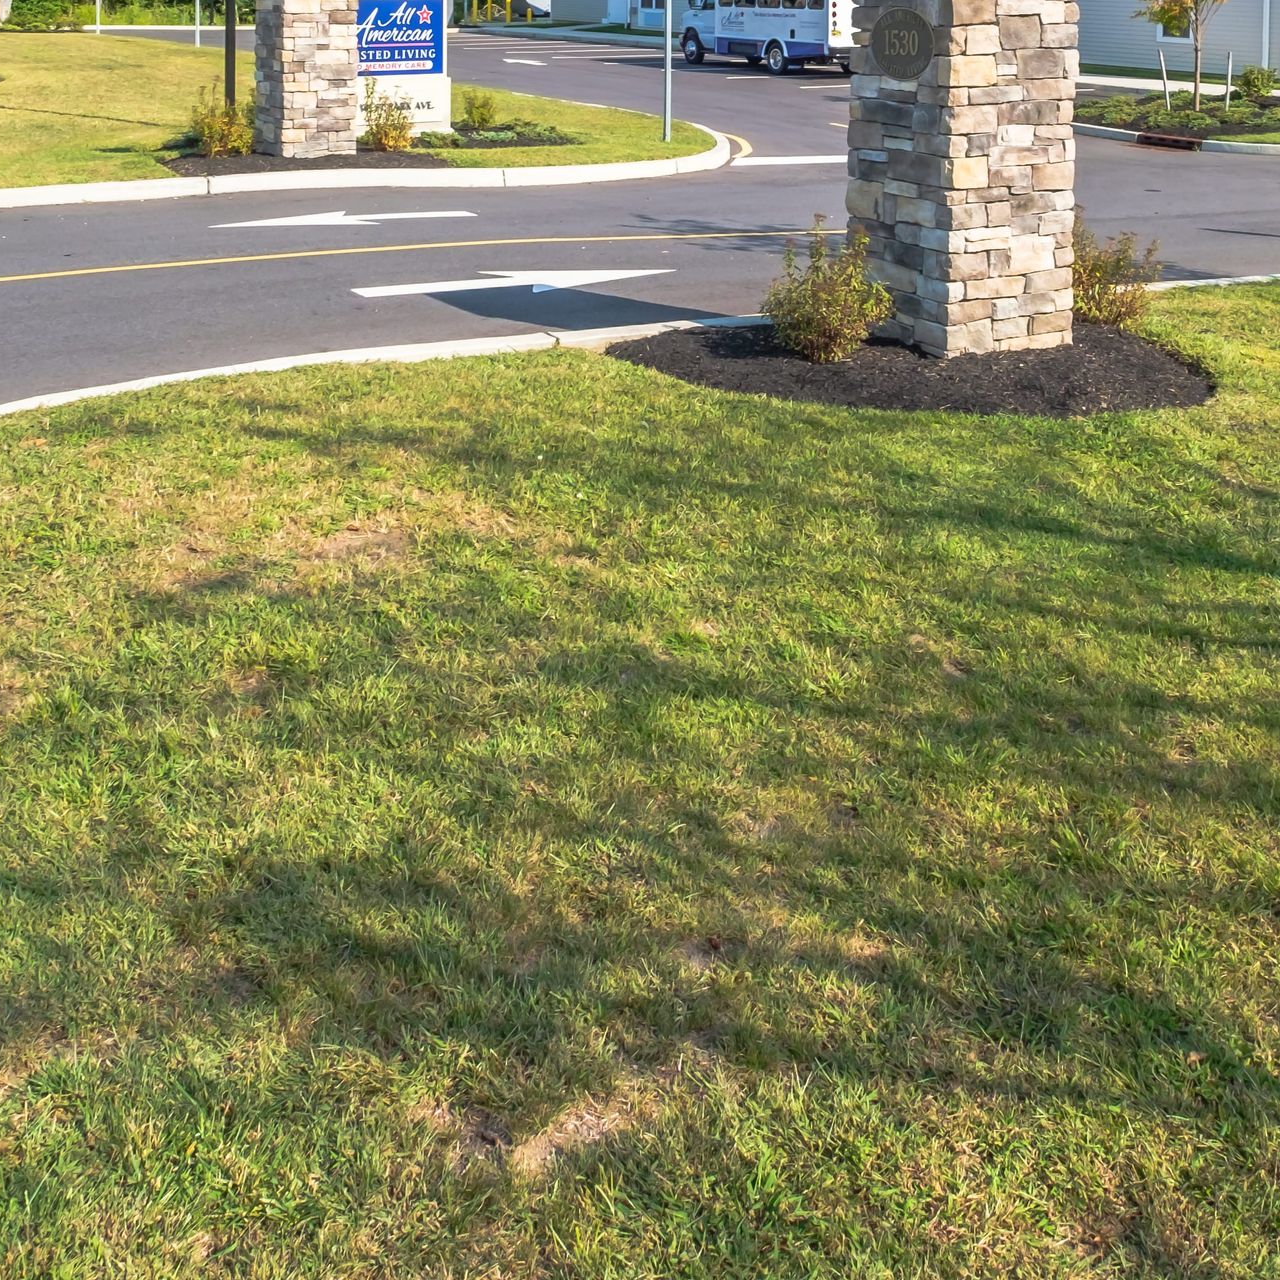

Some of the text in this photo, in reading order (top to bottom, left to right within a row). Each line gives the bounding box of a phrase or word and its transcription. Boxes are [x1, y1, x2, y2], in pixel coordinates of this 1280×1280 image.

[378, 1, 417, 27] All
[357, 7, 434, 48] American
[360, 49, 436, 60] STED LIVING
[884, 30, 919, 56] 1530
[404, 61, 427, 69] CARE
